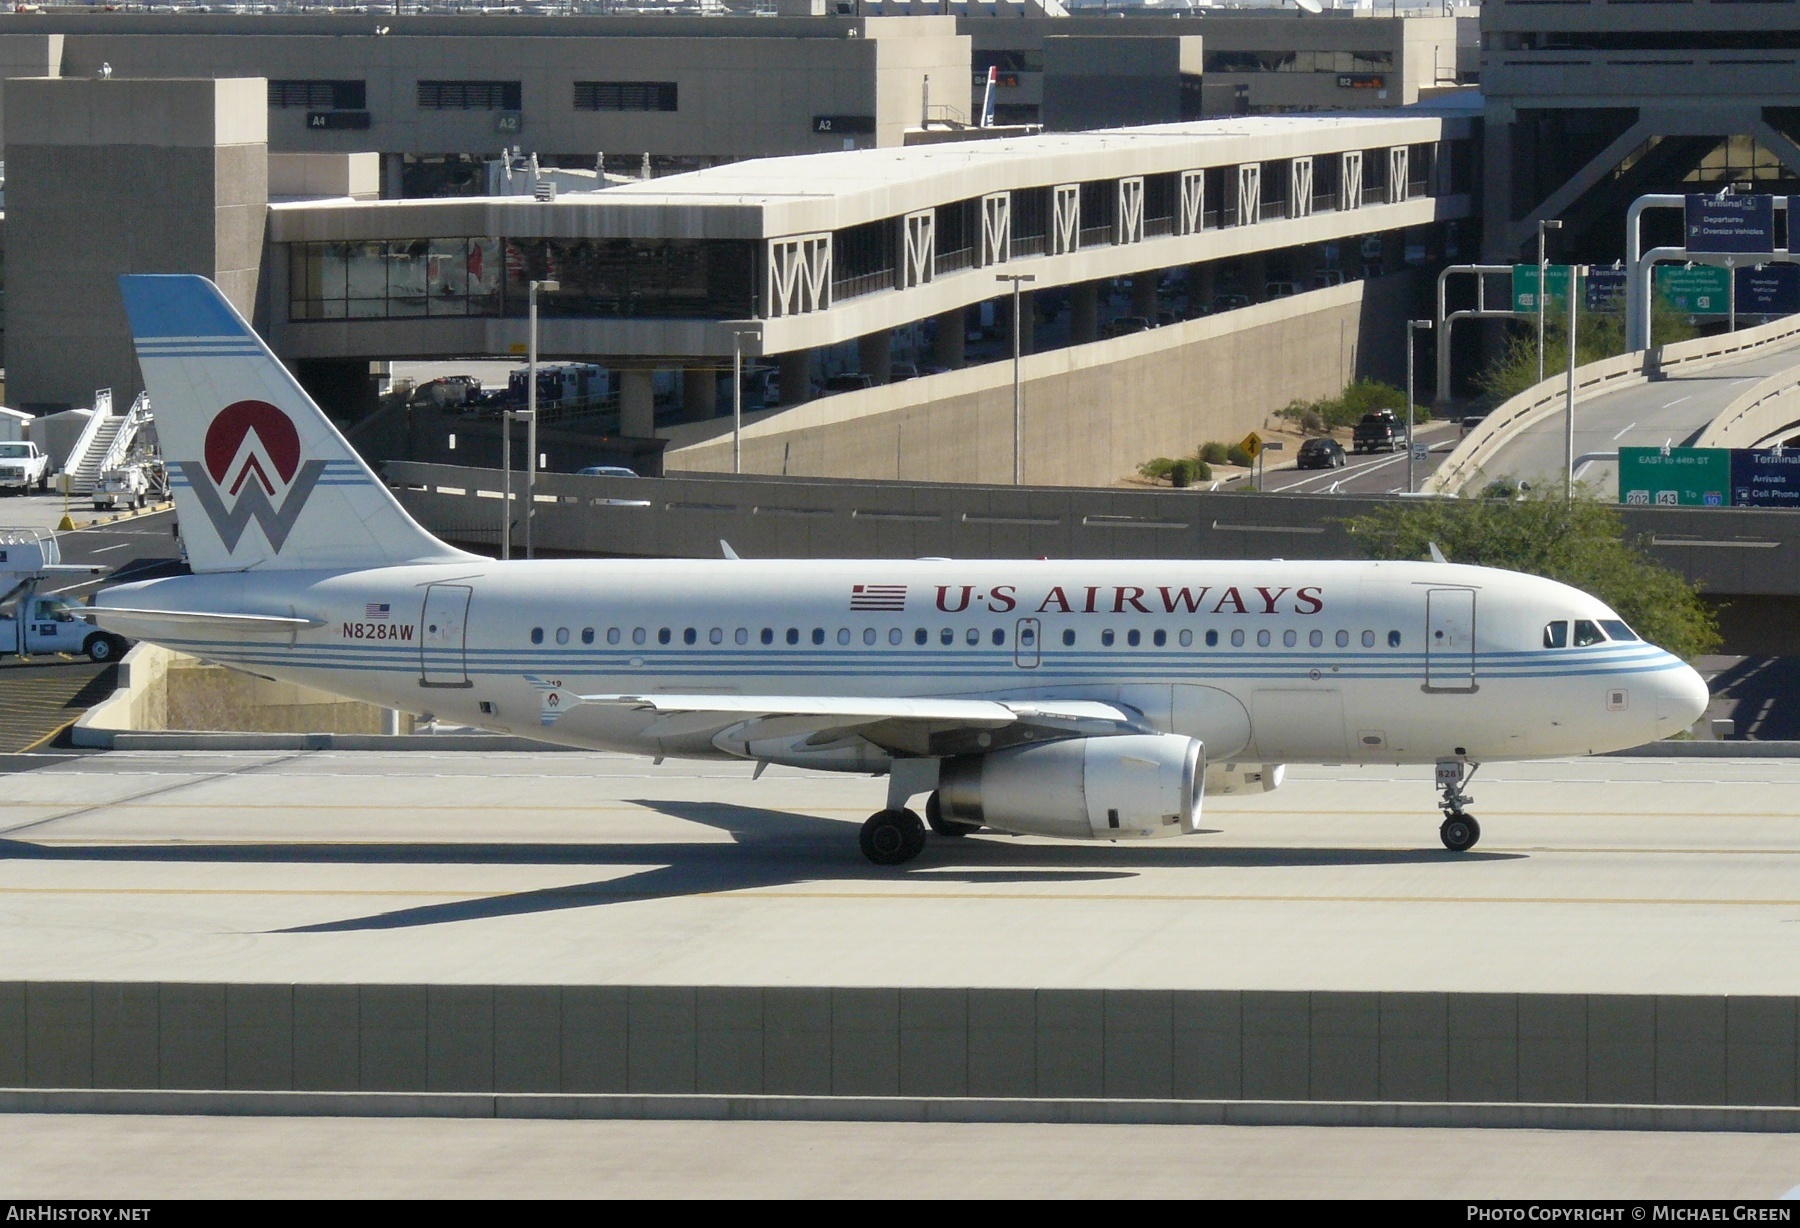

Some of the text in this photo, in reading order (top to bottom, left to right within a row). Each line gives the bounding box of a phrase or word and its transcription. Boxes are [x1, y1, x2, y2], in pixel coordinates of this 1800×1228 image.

[312, 115, 325, 126] A4
[499, 117, 516, 129] A2
[818, 120, 832, 130] A2
[1702, 199, 1742, 208] Terminal
[1703, 216, 1744, 224] Departures
[1702, 227, 1733, 235] Oversize
[1734, 227, 1765, 235] Vehicles
[1414, 452, 1427, 460] 25
[1639, 455, 1709, 465] EAST to 44th ST
[1753, 453, 1800, 464] Terminal
[1753, 475, 1786, 483] Arrivals
[1685, 490, 1697, 498] To
[1752, 489, 1799, 498] Cell Phone
[1628, 494, 1648, 504] 202
[1657, 494, 1677, 505] 143
[1707, 496, 1718, 505] 10
[1034, 585, 1324, 615] AIRWAYS
[343, 622, 414, 640] N828AW
[1437, 770, 1457, 778] 828
